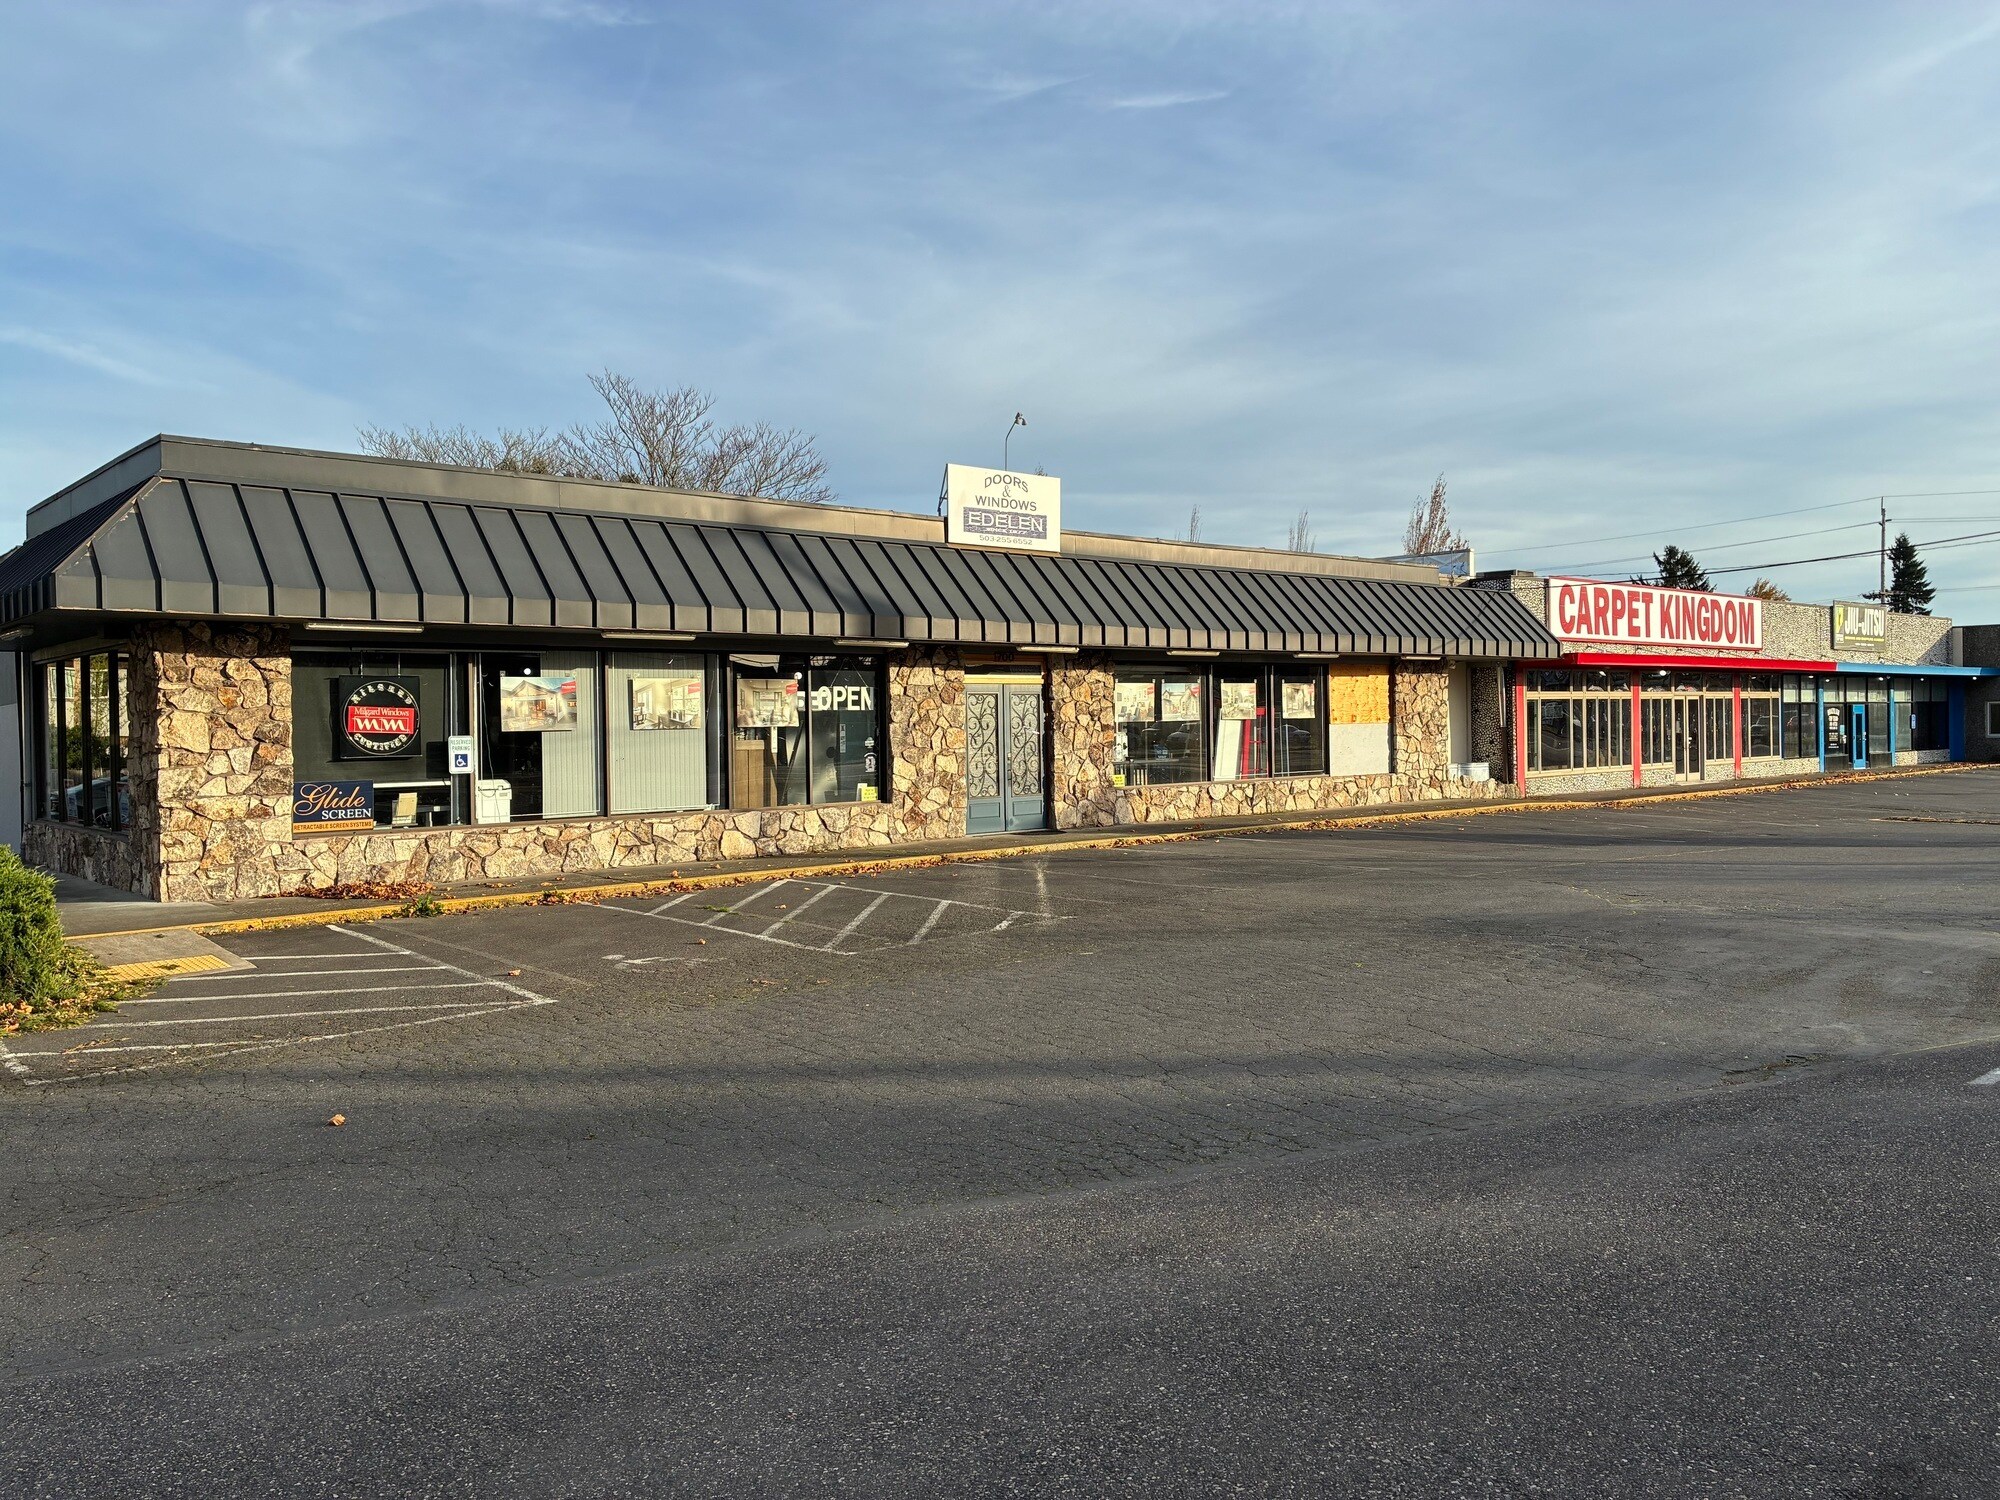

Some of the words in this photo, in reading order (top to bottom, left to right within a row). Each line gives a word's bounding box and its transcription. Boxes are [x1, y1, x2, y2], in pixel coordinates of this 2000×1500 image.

[984, 474, 1029, 493] DOORS
[1002, 485, 1011, 498] &
[975, 495, 1037, 512] WINDOWS
[968, 511, 1044, 532] EDELEN
[1558, 583, 1654, 638] CARPET
[1660, 593, 1755, 645] KINGDOM
[1844, 606, 1885, 637] JIU-JITSU
[817, 685, 874, 711] OPEN
[354, 706, 381, 717] Milgard
[381, 707, 410, 717] Windows
[353, 733, 409, 751] CERTIFIED
[450, 738, 471, 746] RESERVED
[293, 784, 366, 816] Glide
[321, 808, 372, 820] SCREEN
